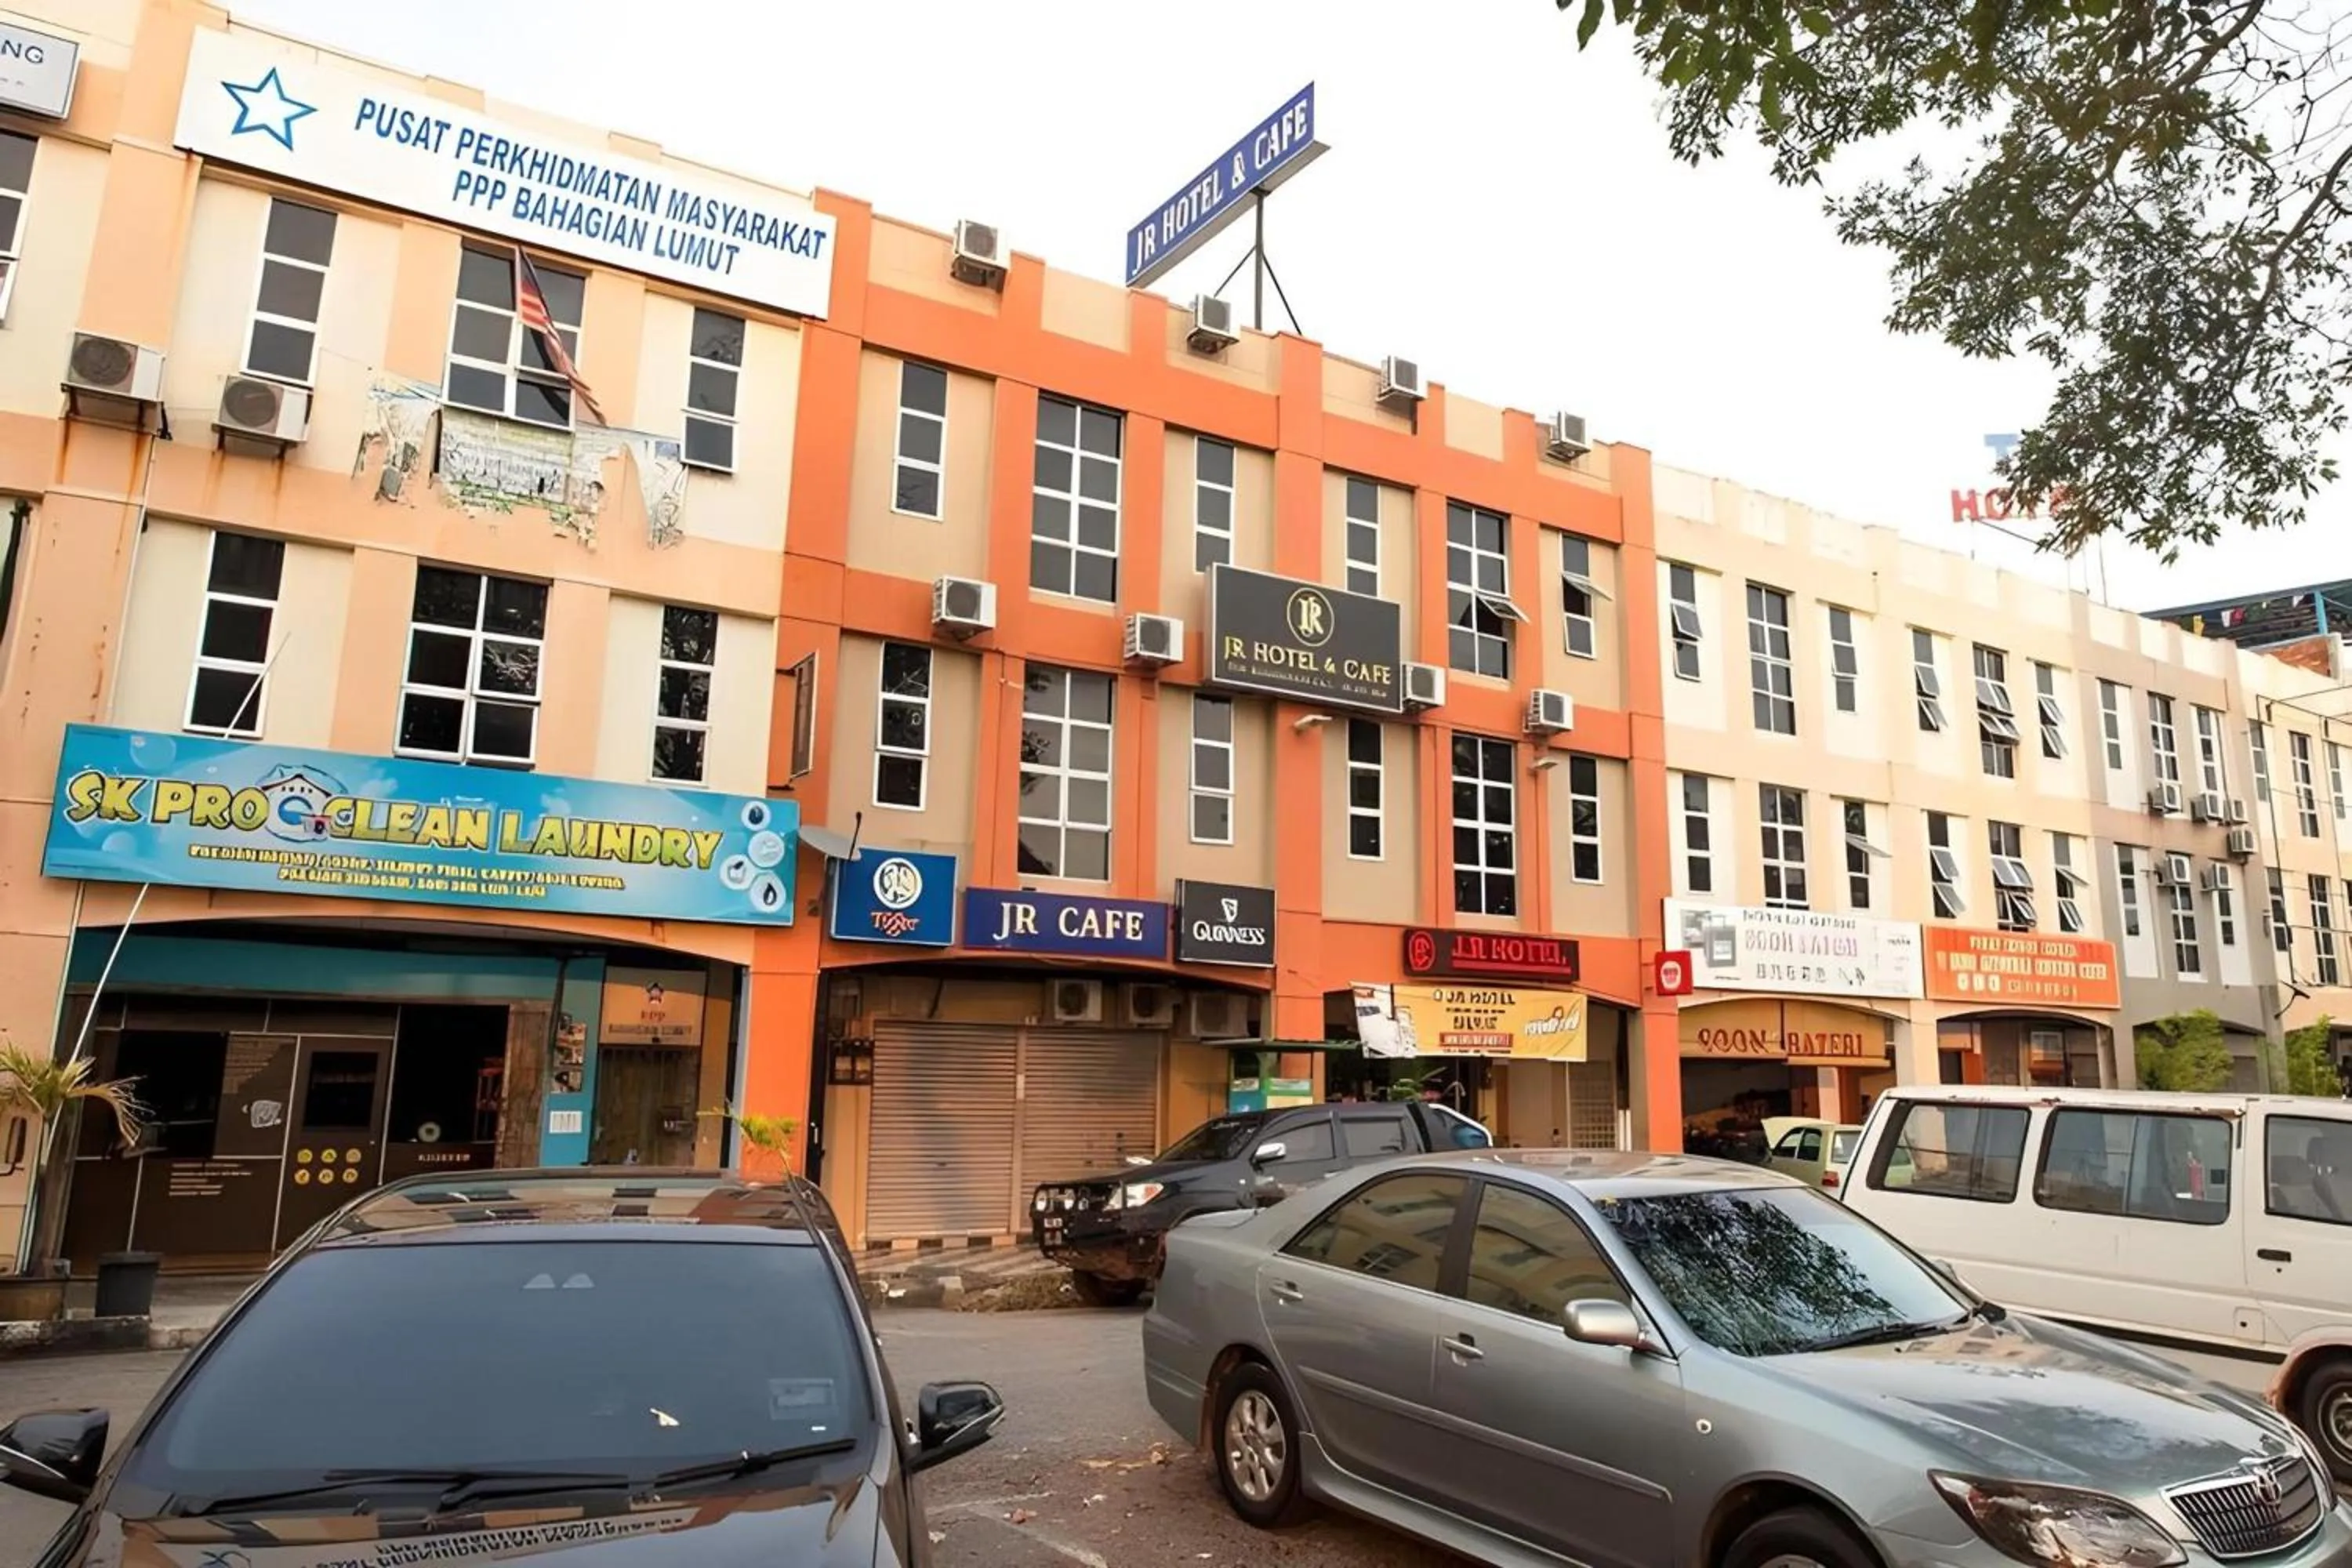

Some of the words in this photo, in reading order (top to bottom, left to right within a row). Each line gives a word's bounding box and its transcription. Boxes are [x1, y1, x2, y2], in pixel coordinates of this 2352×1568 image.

[355, 98, 450, 153] PUSAT
[455, 127, 661, 215] PERKHIDMATAN
[666, 187, 826, 260] MASYARAKAT
[452, 170, 506, 210] PPP
[513, 187, 648, 252] BAHAGIAN
[653, 227, 740, 274] LUMUT
[1132, 222, 1156, 276] JR
[1162, 169, 1224, 245] HOTEL
[1254, 99, 1308, 170] CAFE
[1224, 636, 1247, 660] JR
[1254, 641, 1319, 672] HOTEL
[1344, 659, 1392, 685] CAFE
[67, 770, 147, 824] SK
[151, 779, 270, 832] PRO
[323, 795, 492, 851] CLEAN
[499, 808, 724, 870] LAUNDRY
[993, 902, 1039, 942] JR
[1058, 906, 1145, 941] CAFE
